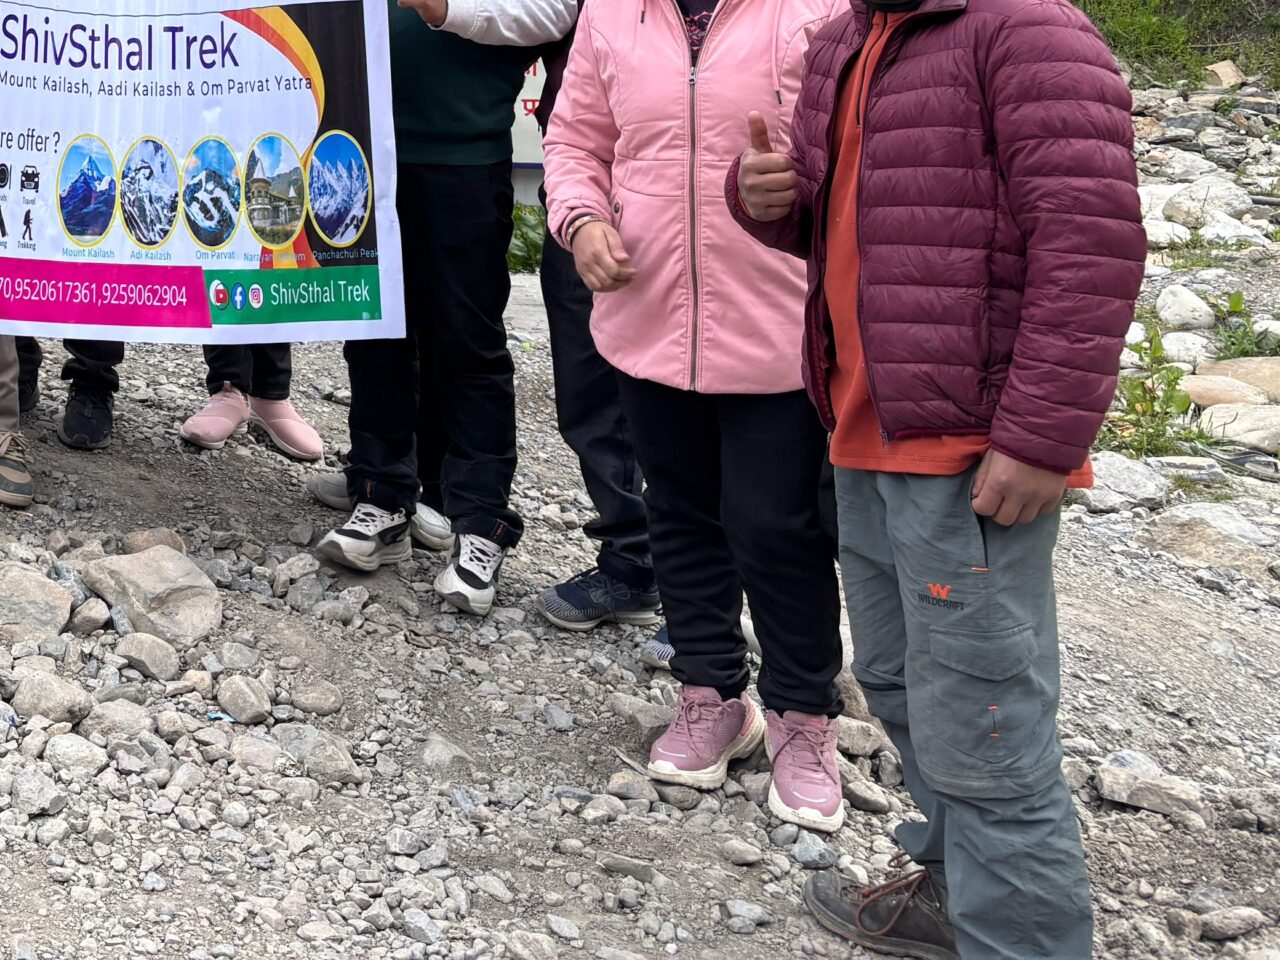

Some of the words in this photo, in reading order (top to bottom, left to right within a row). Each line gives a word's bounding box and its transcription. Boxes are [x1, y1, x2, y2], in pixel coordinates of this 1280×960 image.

[0, 13, 153, 71] ShivSthal
[163, 20, 239, 70] Trek
[43, 74, 93, 97] Kailash,
[98, 80, 128, 97] Aadi
[133, 81, 182, 97] Kailash
[187, 81, 195, 96] &
[200, 80, 223, 96] Om
[228, 77, 270, 95] Parvat
[274, 75, 312, 91] Yatra
[17, 128, 50, 152] offer
[62, 248, 86, 258] Mount
[87, 248, 115, 259] Kailash
[130, 251, 143, 260] Adi
[144, 251, 172, 261] Kailash
[195, 250, 210, 260] Om
[211, 250, 235, 260] Parvat
[312, 249, 359, 261] Panchachuli
[270, 279, 335, 306] ShivSthal
[337, 278, 370, 303] Trek
[918, 592, 965, 611] WILDCRAFT
